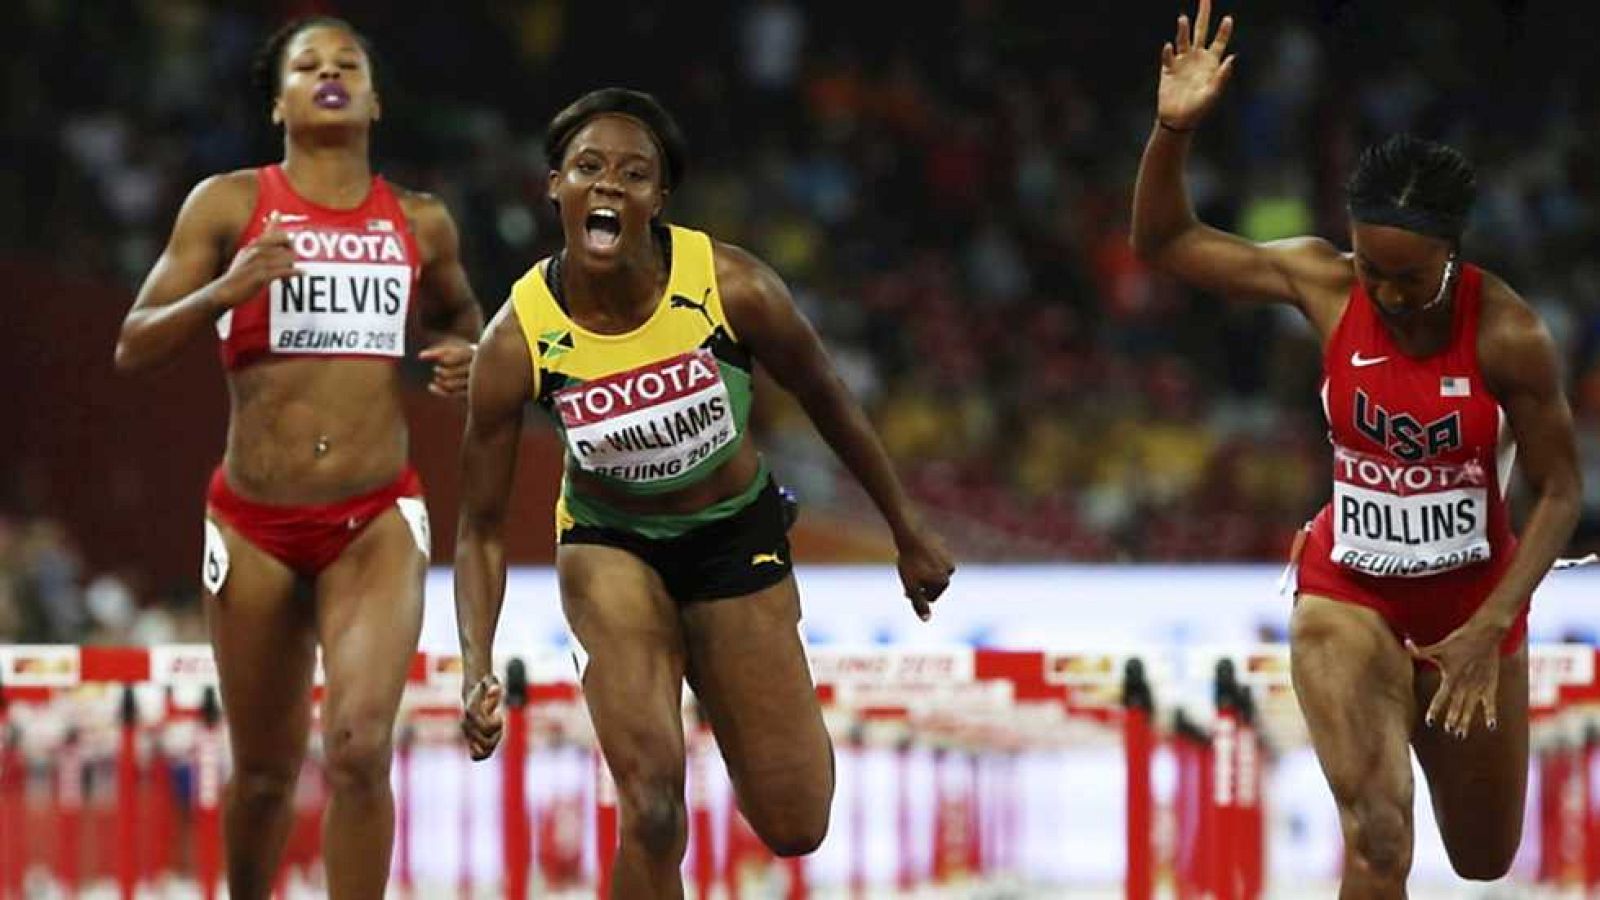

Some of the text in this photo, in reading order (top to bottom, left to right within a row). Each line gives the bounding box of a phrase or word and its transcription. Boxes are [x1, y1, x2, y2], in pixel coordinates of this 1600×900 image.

[281, 275, 402, 316] NELVIS
[278, 329, 360, 350] BEIJING
[560, 361, 714, 420] TOYOTA
[605, 397, 726, 452] WILLIAMS
[686, 430, 730, 466] 2015
[1354, 388, 1462, 460] USA
[1341, 496, 1475, 544] ROLLINS
